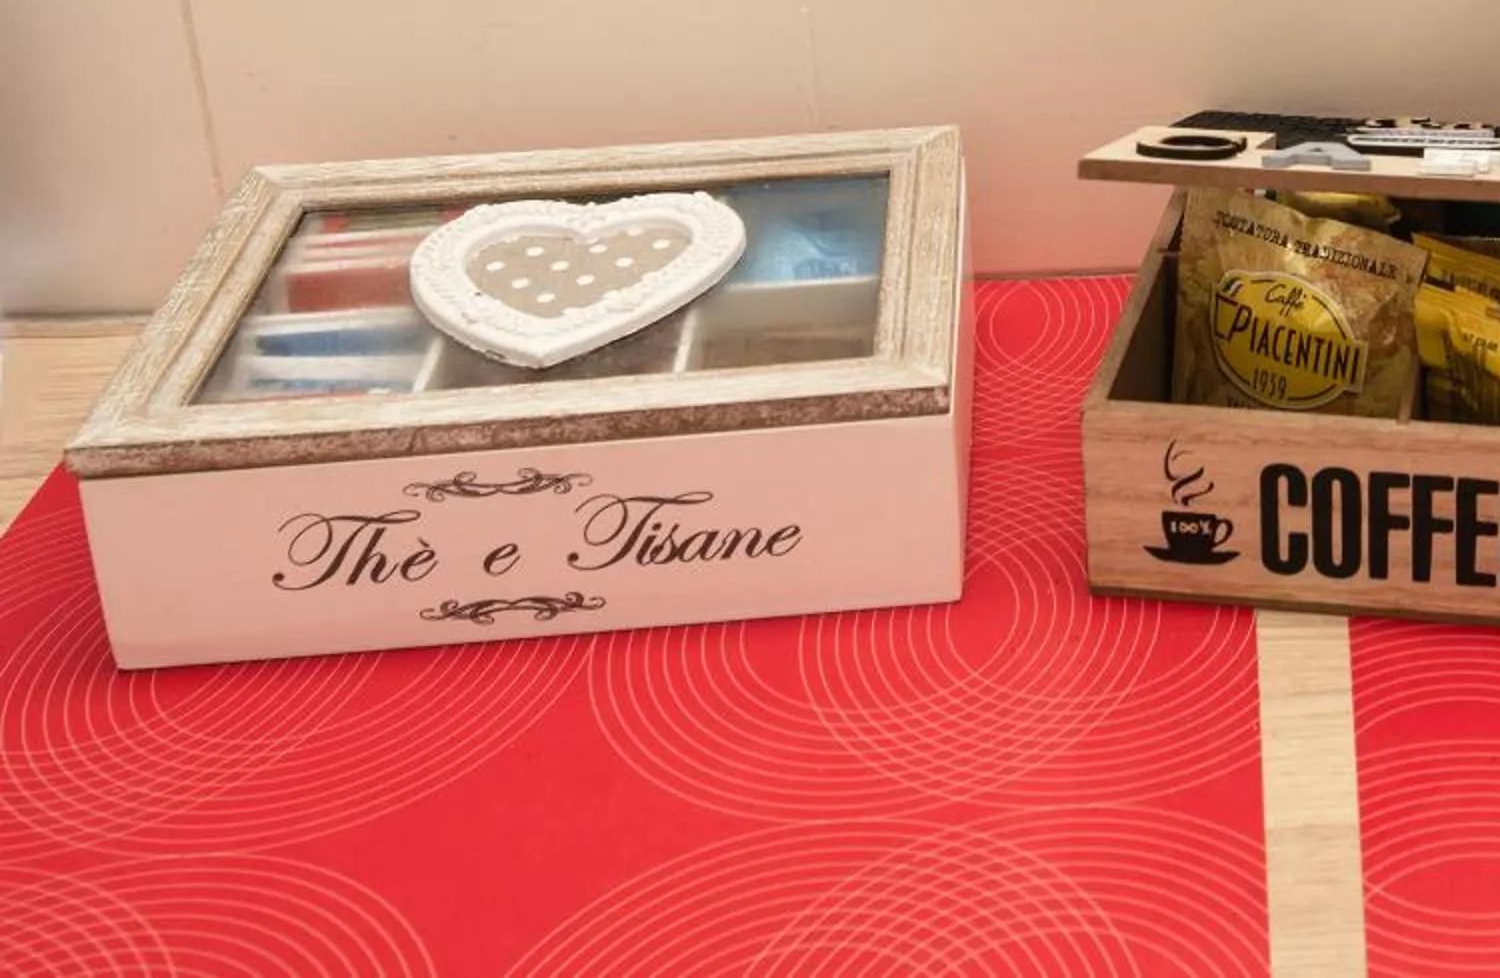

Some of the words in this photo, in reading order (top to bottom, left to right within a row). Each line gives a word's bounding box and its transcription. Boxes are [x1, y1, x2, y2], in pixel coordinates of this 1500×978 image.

[1225, 303, 1361, 386] PIACENTINI
[1252, 366, 1288, 400] 1959
[271, 508, 438, 591] Thè
[482, 539, 521, 577] e
[566, 490, 804, 572] Tisane
